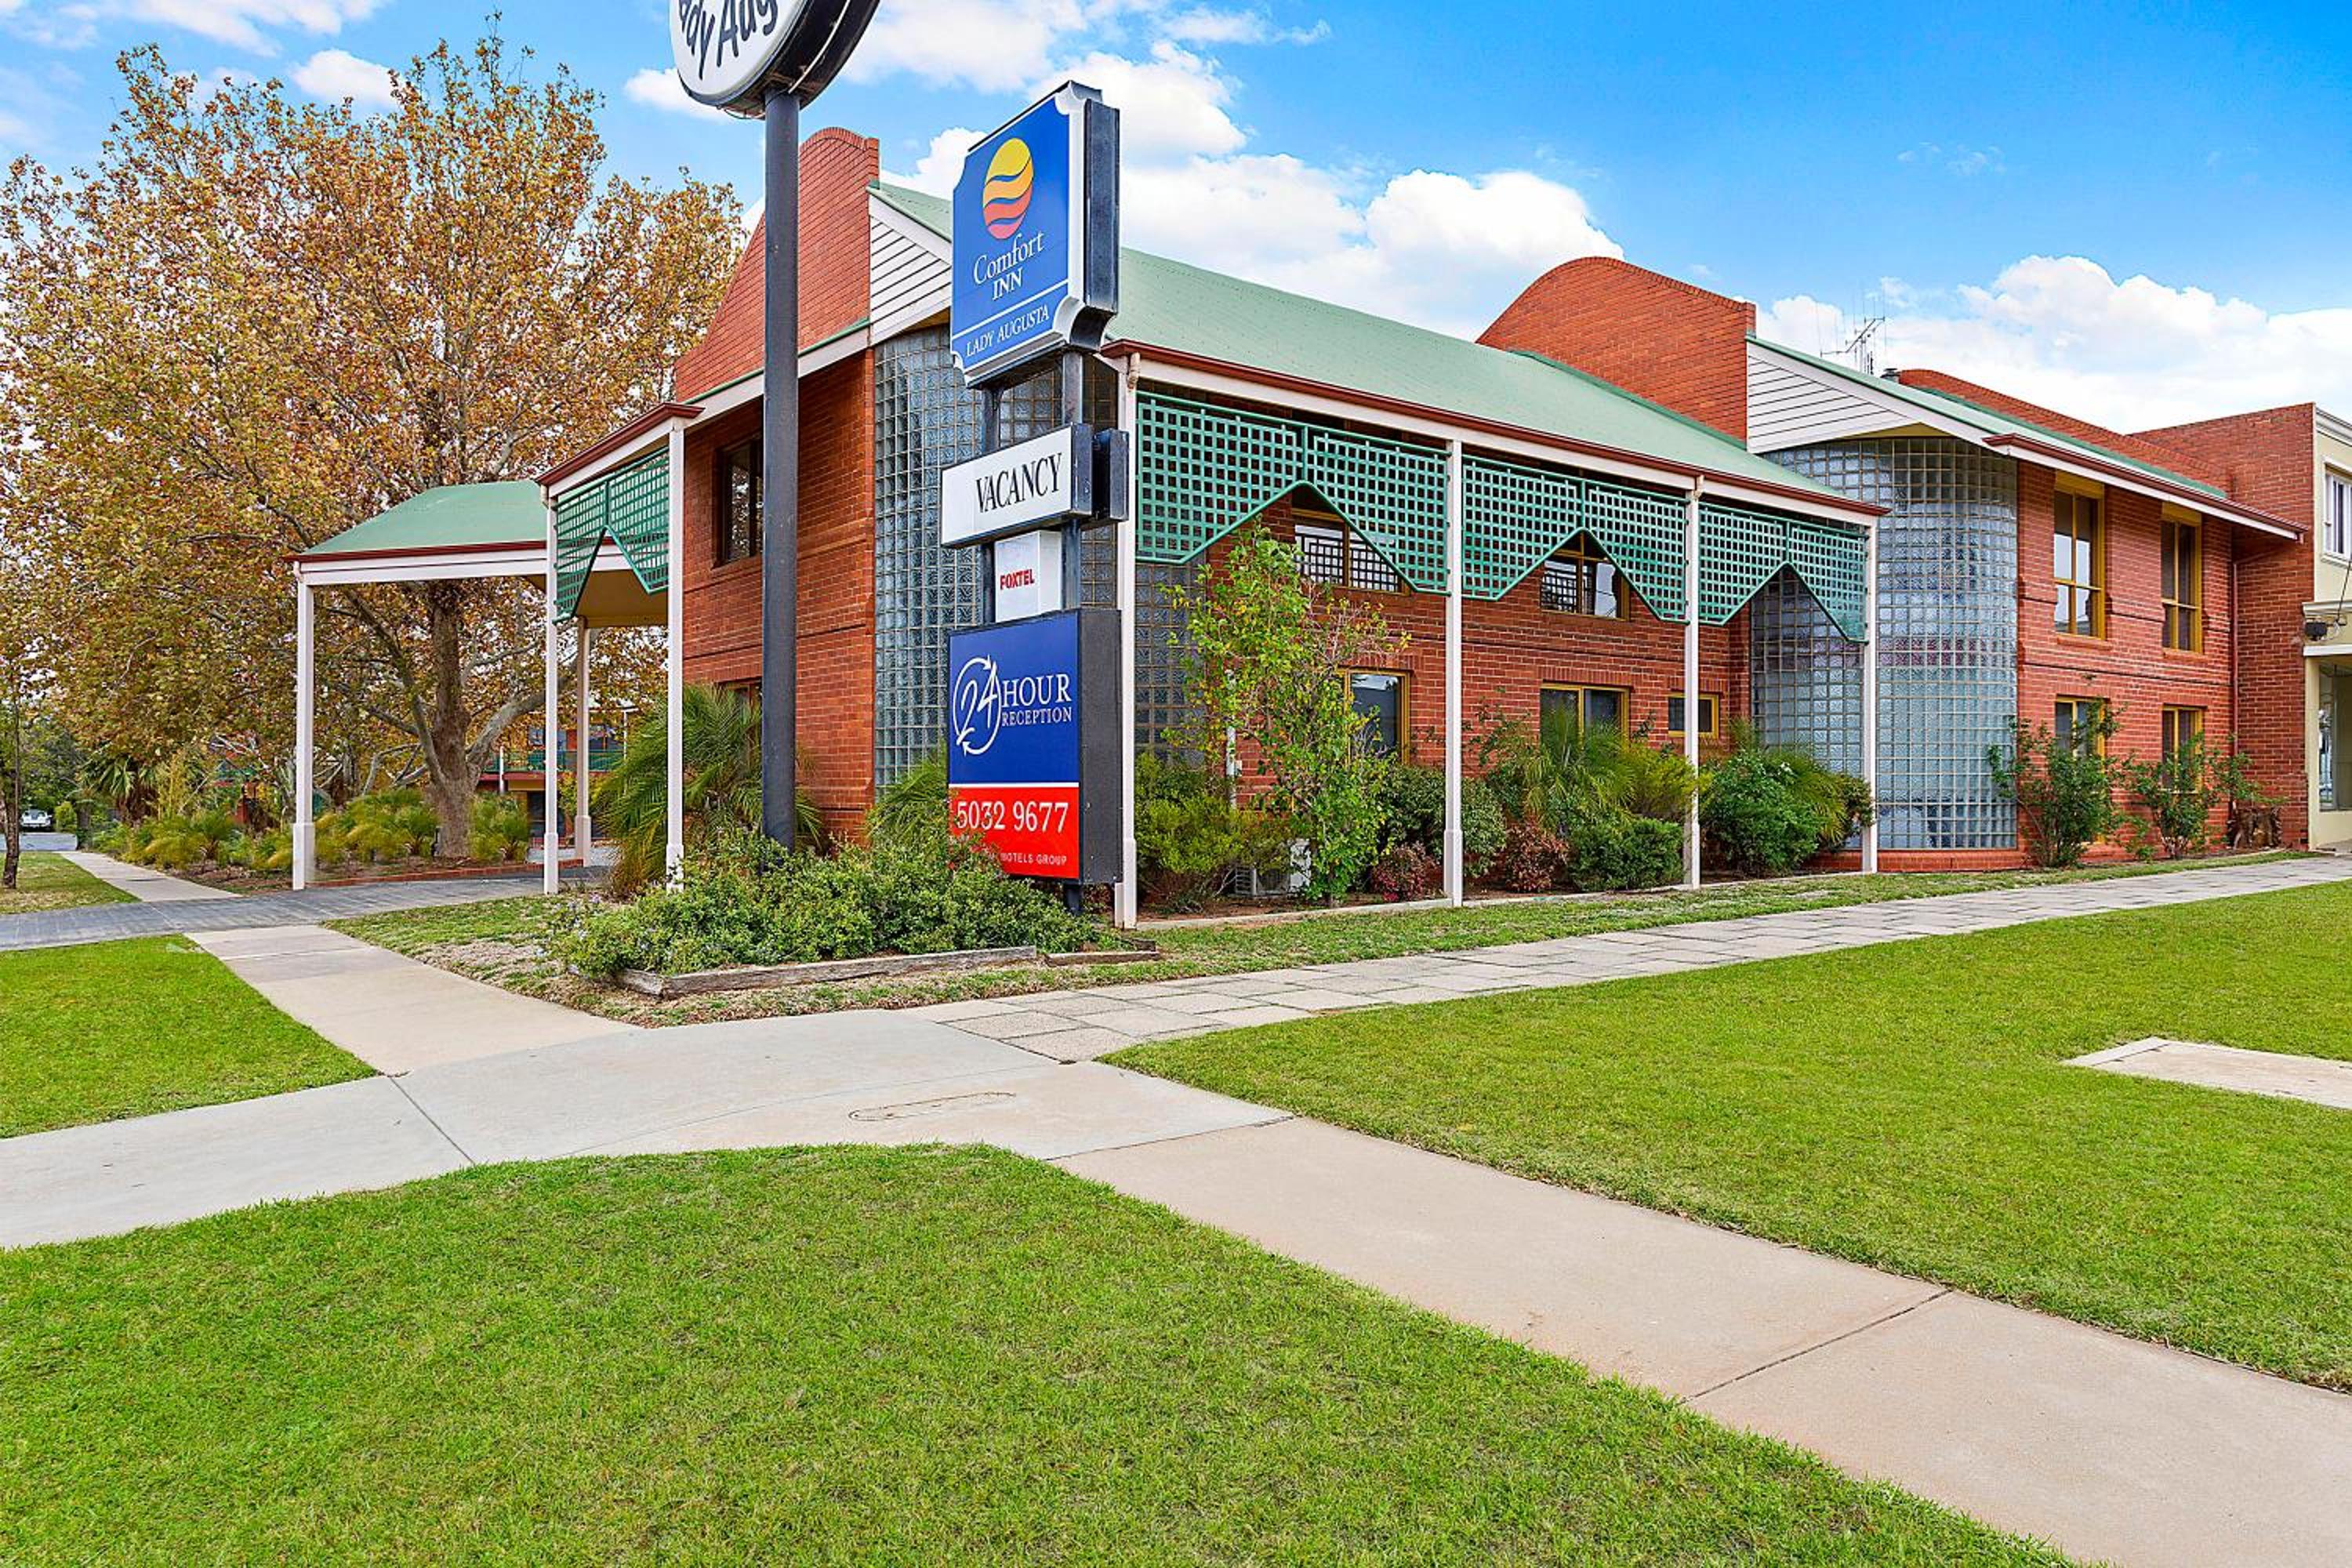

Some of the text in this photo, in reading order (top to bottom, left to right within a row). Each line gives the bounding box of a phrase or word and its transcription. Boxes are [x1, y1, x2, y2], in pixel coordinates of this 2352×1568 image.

[974, 230, 1044, 285] Comfort
[992, 267, 1023, 301] INN
[966, 303, 1050, 358] LADY AUGUSTA
[975, 452, 1062, 514] VACANCY
[1000, 568, 1035, 590] FOXTEL
[956, 660, 1073, 746] 24 HOUR
[1001, 706, 1073, 727] RECEPTION
[956, 800, 1069, 833] 5032 9677
[1036, 854, 1067, 866] GROUP
